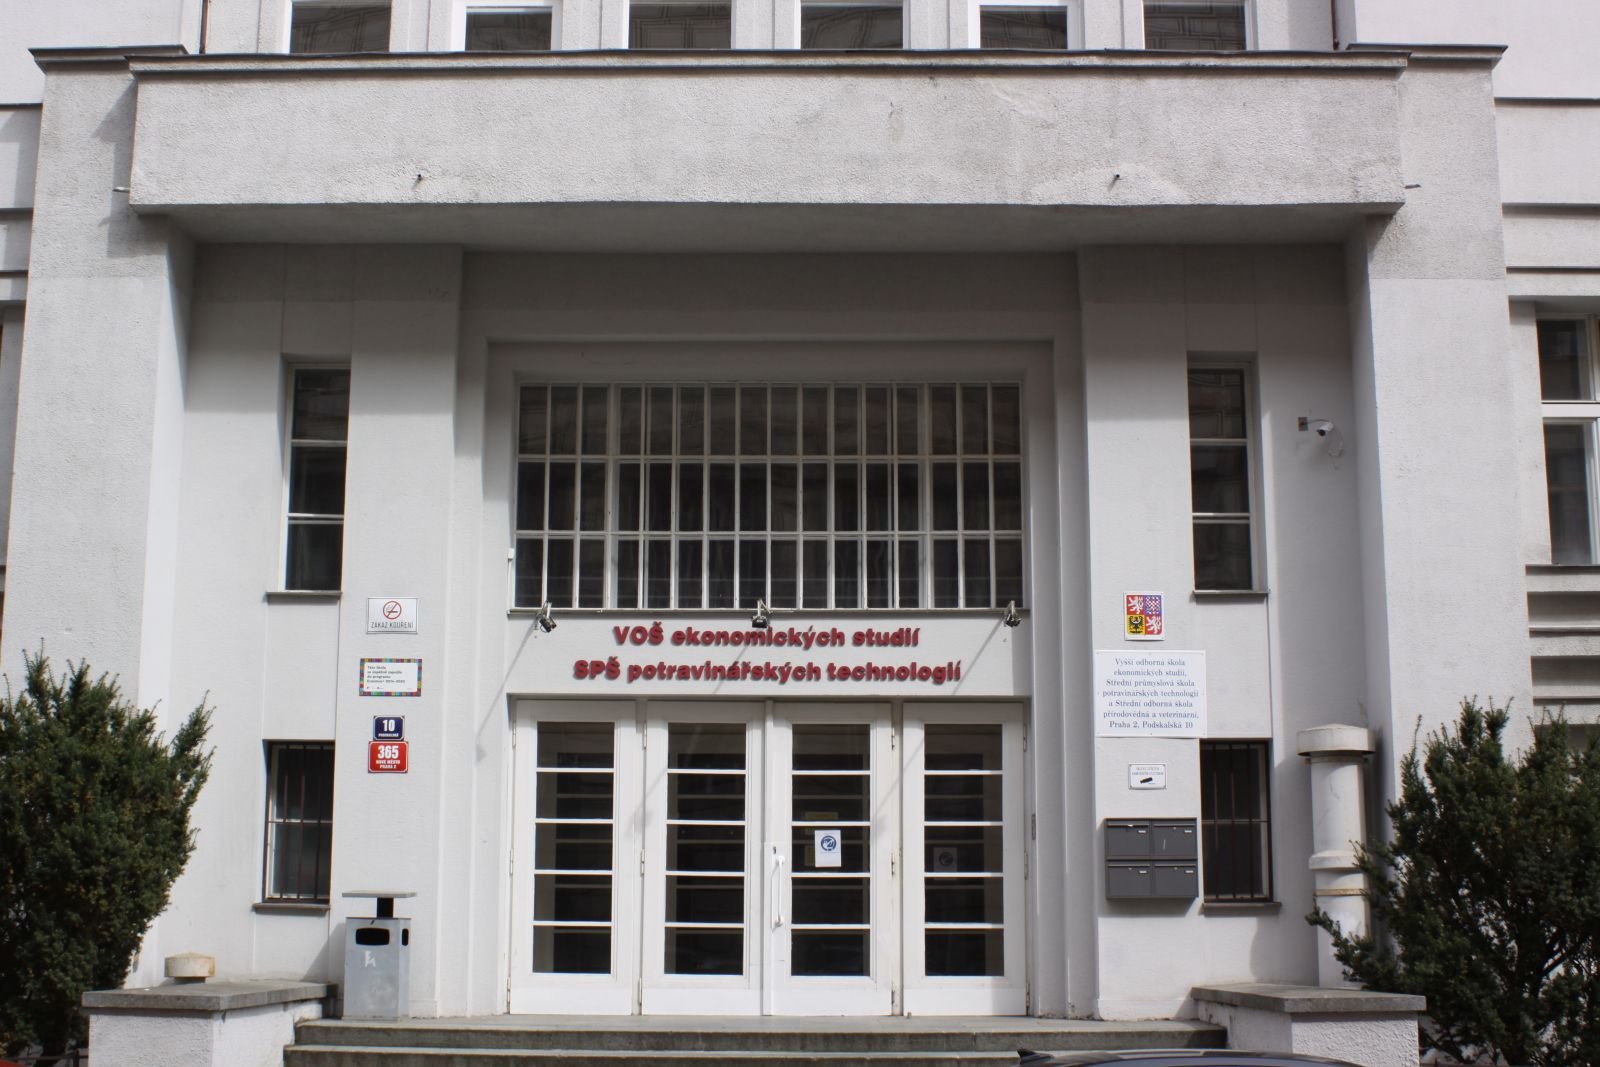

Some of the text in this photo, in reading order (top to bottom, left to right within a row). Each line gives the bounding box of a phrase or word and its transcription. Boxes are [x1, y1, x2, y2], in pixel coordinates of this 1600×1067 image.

[613, 621, 920, 650] VOŠ ekonomických studií
[1115, 658, 1134, 667] Vyšší
[1136, 658, 1165, 666] odborná
[573, 656, 961, 685] SPŠ potravinářských technologií
[1113, 668, 1163, 678] ekonomických
[1106, 678, 1195, 688] Střední průmyslová škola
[1102, 689, 1199, 698] potravinářských technologií
[1115, 699, 1141, 707] Střední
[1174, 700, 1193, 708] škola
[1103, 710, 1150, 719] přírodovědná
[382, 719, 395, 731] 10
[1109, 720, 1131, 728] Praha
[1142, 720, 1182, 729] Podskalská
[1184, 721, 1194, 729] 10
[377, 745, 399, 759] 365
